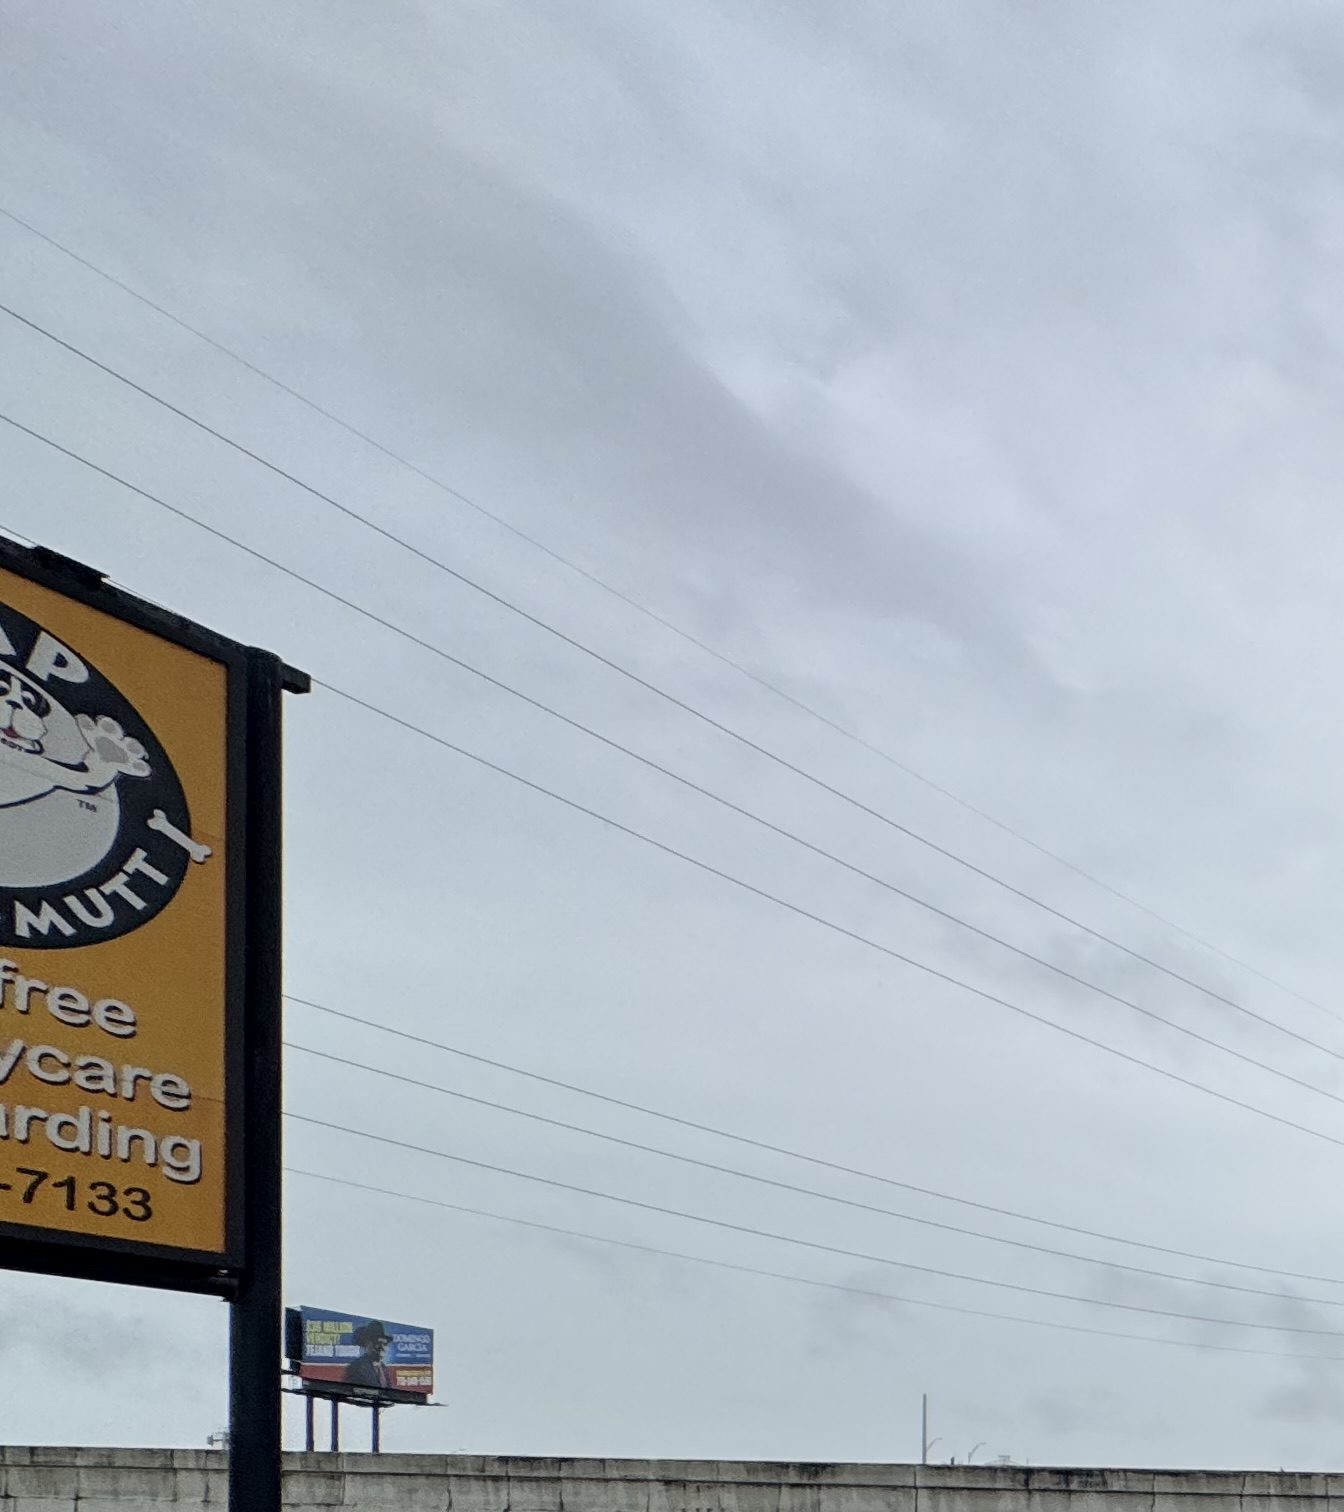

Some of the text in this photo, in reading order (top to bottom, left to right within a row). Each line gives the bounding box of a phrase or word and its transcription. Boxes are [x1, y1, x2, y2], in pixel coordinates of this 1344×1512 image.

[13, 847, 170, 939] MUTT
[0, 1103, 202, 1184] rding
[392, 1333, 431, 1344] DOMINGO
